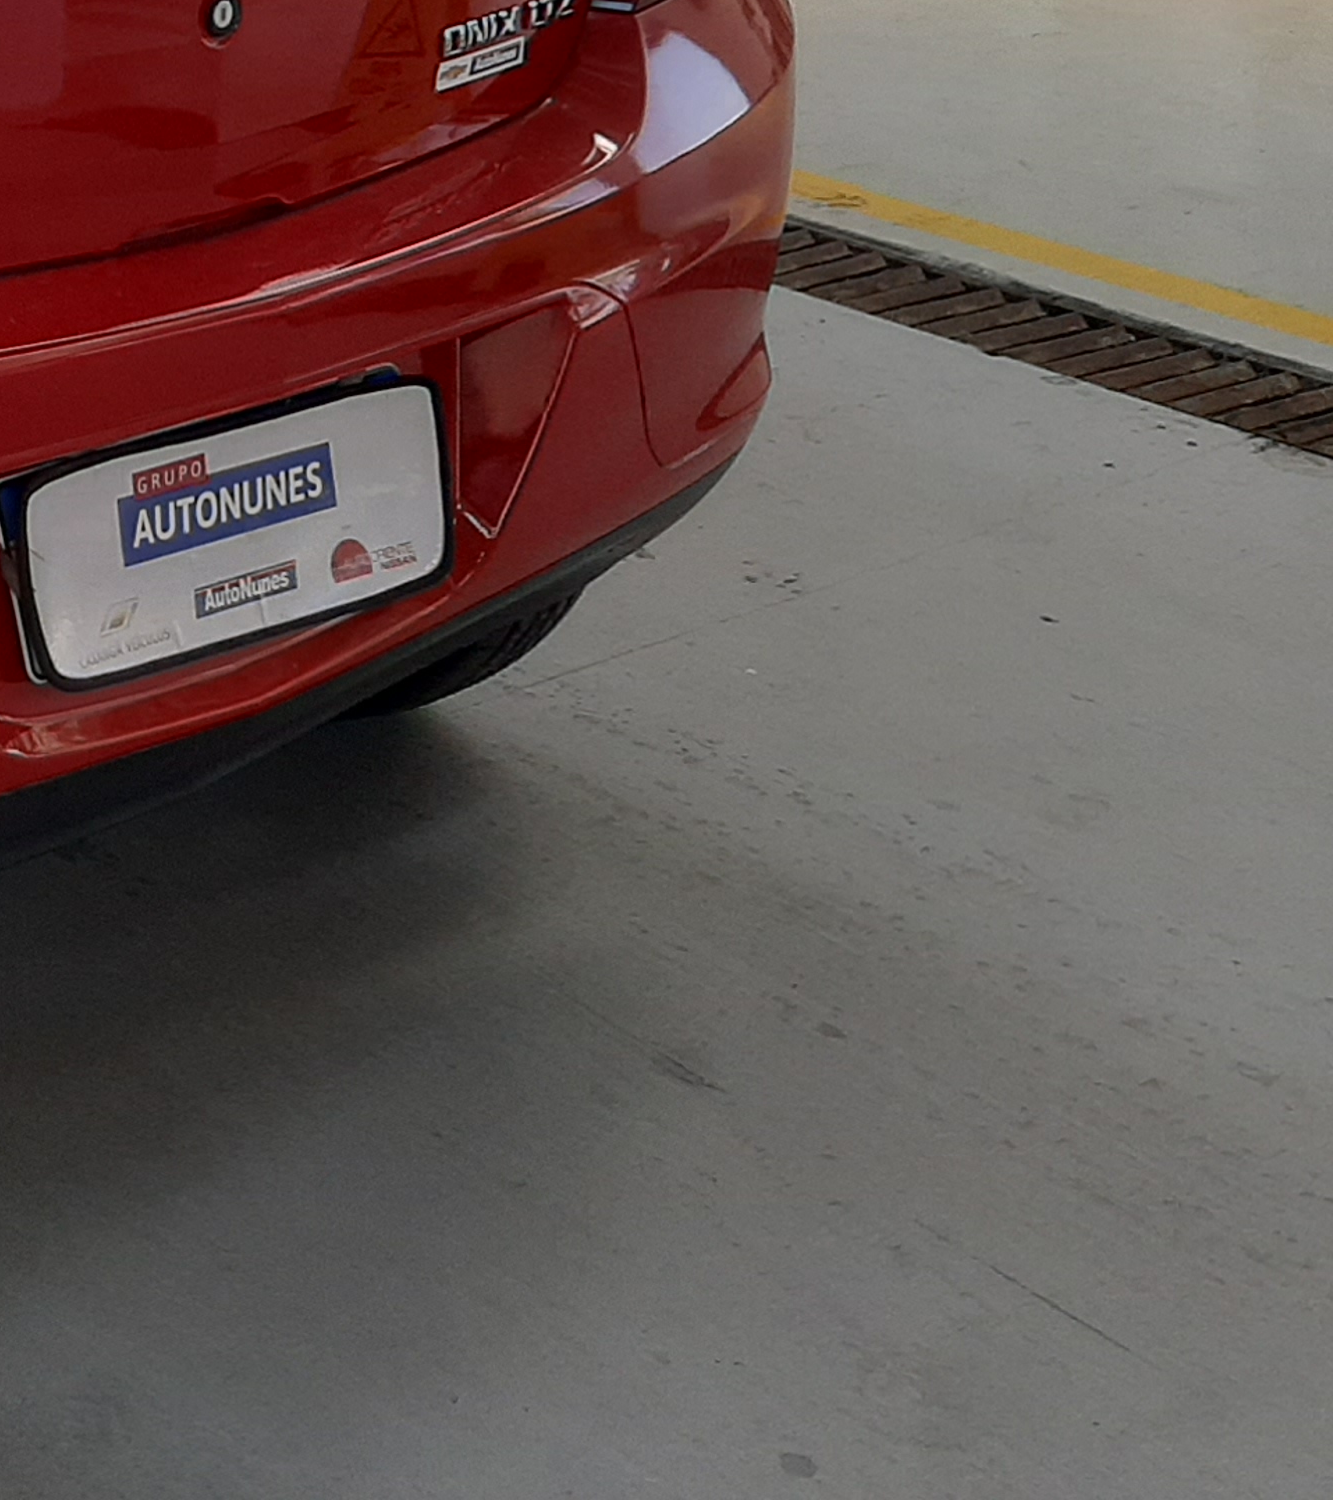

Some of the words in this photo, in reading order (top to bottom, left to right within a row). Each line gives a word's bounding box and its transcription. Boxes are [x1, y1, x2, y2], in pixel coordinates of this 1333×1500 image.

[443, 5, 522, 57] ONIX
[137, 460, 202, 495] GRUPO
[134, 461, 323, 549] AUTONUNES
[204, 571, 290, 611] AutoNunes
